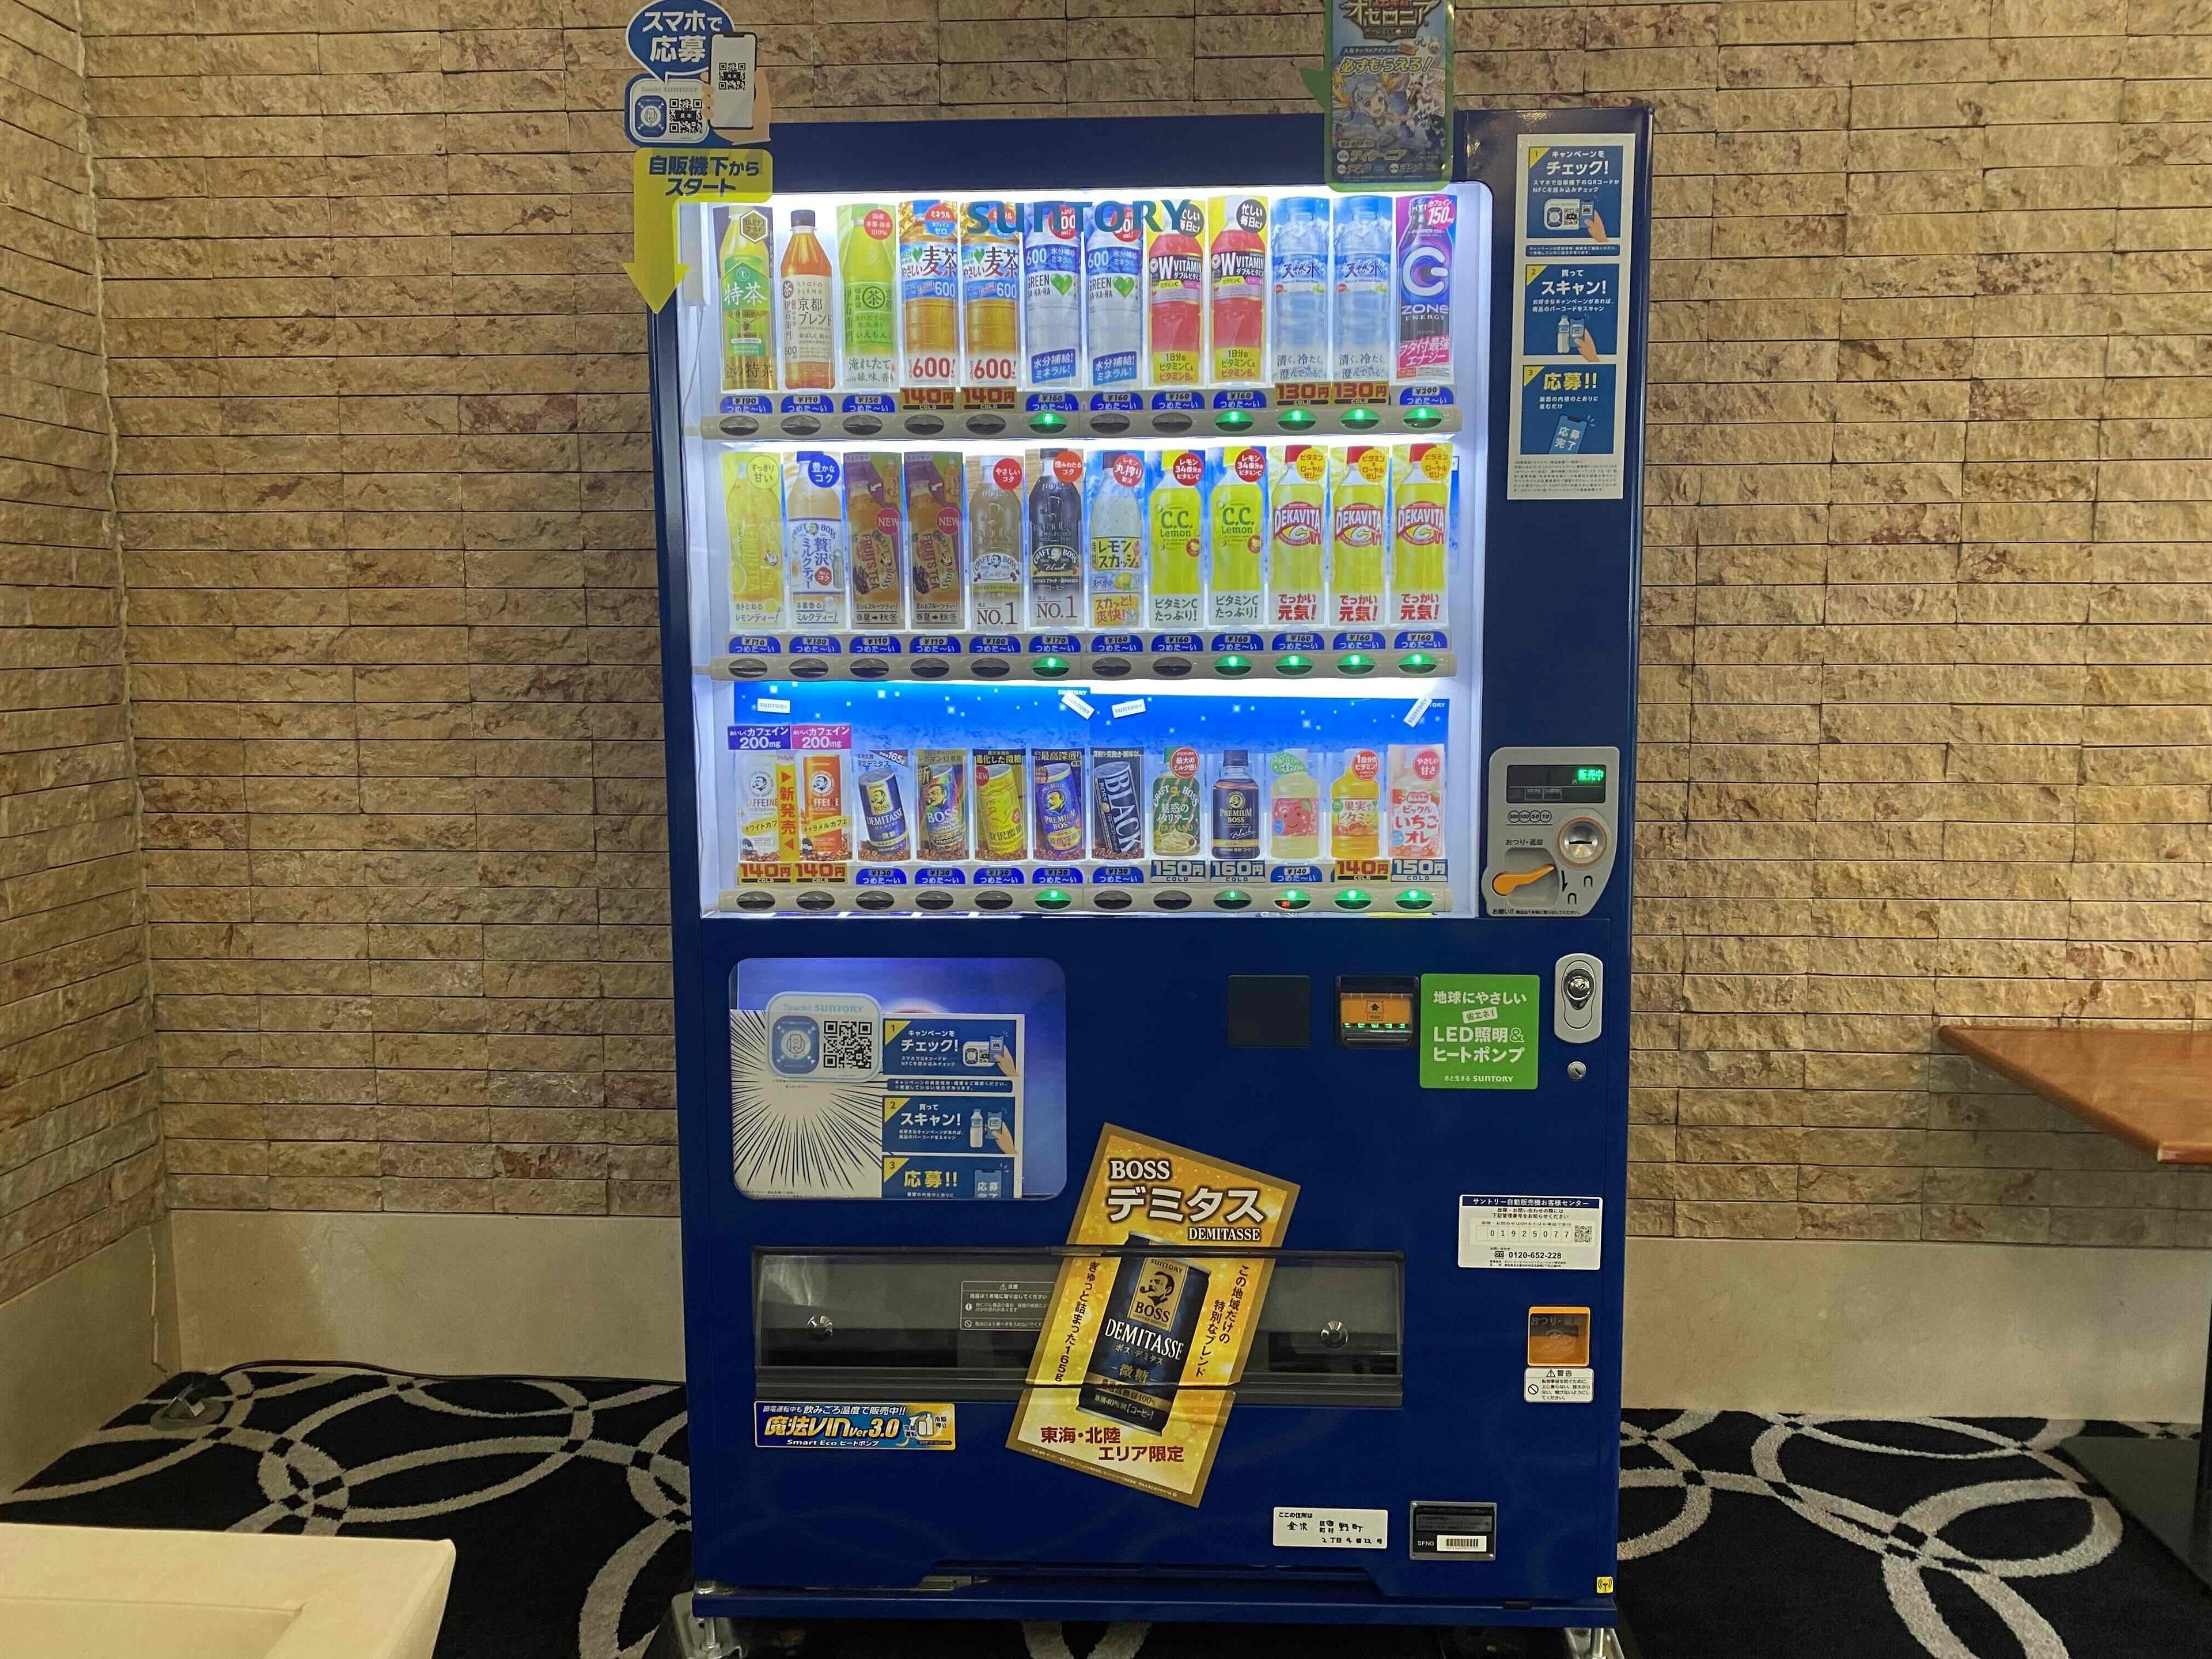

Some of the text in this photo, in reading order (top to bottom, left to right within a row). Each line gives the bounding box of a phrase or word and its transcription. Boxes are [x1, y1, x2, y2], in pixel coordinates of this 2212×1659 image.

[642, 11, 722, 32] スマホで
[650, 36, 706, 62] 応募
[1552, 150, 1605, 158] キャンペーンを
[649, 156, 760, 176] 自販機下から
[1546, 161, 1609, 176] チェック!
[665, 178, 736, 198] スタート
[930, 210, 951, 220] ミネラル
[967, 199, 1192, 234] SUNTORY
[1241, 203, 1263, 217] 忙しい
[1240, 216, 1263, 230] 毎日に!
[922, 245, 957, 277] 麦茶
[983, 246, 1019, 278] 麦茶
[1027, 249, 1047, 265] 600
[1088, 250, 1109, 268] 600
[1281, 261, 1321, 279] 天然水
[1344, 261, 1384, 279] 天然水
[724, 281, 768, 306] 特茶
[1541, 281, 1607, 296] スキャン!
[798, 297, 823, 312] 京都
[1033, 353, 1074, 369] 水分補給!
[1094, 354, 1135, 372] 水分補給!
[1035, 365, 1071, 380] ミネラル!
[1096, 367, 1132, 382] ミネラル!
[1543, 372, 1597, 391] 応募!!
[903, 388, 954, 404] 140円
[963, 388, 1015, 403] 140円
[1277, 384, 1330, 399] 130円
[1334, 382, 1387, 399] 130円
[1558, 426, 1581, 440] 応募
[1555, 440, 1577, 451] 完了
[1179, 459, 1198, 467] レモン
[1241, 454, 1261, 463] レモン
[811, 463, 835, 474] 豊かな
[995, 468, 1020, 476] やさしい
[1300, 465, 1323, 473] ローヤル
[1425, 465, 1448, 473] ローヤル
[815, 474, 834, 484] コク
[877, 517, 899, 527] NEW
[938, 517, 960, 527] NEW
[1160, 510, 1193, 529] C.C.
[1221, 506, 1255, 526] C.C.
[1274, 510, 1321, 531] DEKAVITA
[1335, 509, 1382, 531] DEKAVITA
[1397, 509, 1445, 530] DEKAVITA
[1160, 529, 1191, 537] Lemon
[1221, 525, 1253, 535] Lemon
[1099, 540, 1133, 554] レモン
[1062, 548, 1078, 564] BOSS
[1095, 595, 1132, 609] スカッと!
[1154, 597, 1198, 609] ビタミンC
[1215, 594, 1259, 607] ビタミンC
[1278, 594, 1316, 604] でっかい
[1339, 594, 1377, 605] でっかい
[1400, 593, 1439, 604] でっかい
[940, 613, 958, 622] 秋冬
[1154, 610, 1197, 622] たっぷり!
[1215, 607, 1257, 619] たっぷり!
[1278, 604, 1317, 621] 元気!
[1339, 605, 1378, 622] 元気!
[1400, 604, 1440, 620] 元気!
[1107, 635, 1128, 643] ¥160
[759, 702, 788, 710] SUNTORY
[1114, 704, 1143, 714] SUNTORY
[729, 727, 789, 737] おいしくカフェイン
[793, 726, 850, 736] おいしくカフェイン
[739, 736, 781, 749] 200mg
[802, 736, 842, 749] 200mg
[1416, 757, 1440, 765] やさしい
[1421, 766, 1436, 776] 甘さ
[1181, 785, 1199, 807] BOSS
[779, 787, 796, 835] 新発売
[926, 805, 959, 823] BOSS
[1104, 771, 1142, 853] BLACK
[1219, 808, 1252, 817] PREMIUM
[1395, 816, 1439, 830] いちご
[1404, 832, 1429, 844] オレ
[1505, 838, 1543, 846] おつり・返却
[740, 863, 791, 877] 140円
[795, 863, 846, 877] 140円
[1153, 861, 1205, 876] 150円
[1211, 861, 1265, 876] 160円
[1337, 860, 1388, 874] 140円
[1393, 860, 1445, 875] 150円
[1432, 991, 1528, 1005] 地球にやさしい
[814, 1003, 864, 1014] SUNTORY
[1466, 1009, 1496, 1021] 省エネ!
[1433, 1027, 1525, 1044] LED照明&
[901, 1039, 959, 1052] チェック!
[1433, 1046, 1526, 1063] ヒートポンプ
[1472, 1075, 1514, 1083] SUNTORY
[919, 1103, 940, 1111] 買って
[900, 1112, 961, 1126] スキャン!
[1110, 1160, 1170, 1180] BOSS
[904, 1170, 958, 1188] 応募!!
[1107, 1185, 1264, 1223] デミタス
[1472, 1198, 1589, 1207] サントリー自動販売機お客様センター
[1188, 1227, 1260, 1241] DEMITASSE
[1508, 1251, 1562, 1259] 0120-652-228
[1149, 1258, 1183, 1274] SUNTORY
[1218, 1264, 1250, 1344] この地域だけの
[1134, 1301, 1171, 1324] BOSS
[1104, 1318, 1184, 1361] DEMITASSE
[1195, 1300, 1226, 1377] 特別なブレンド
[1040, 1426, 1121, 1445] 東海・北陸
[1098, 1446, 1184, 1463] エリア限定
[1286, 1521, 1308, 1531] 金沢
